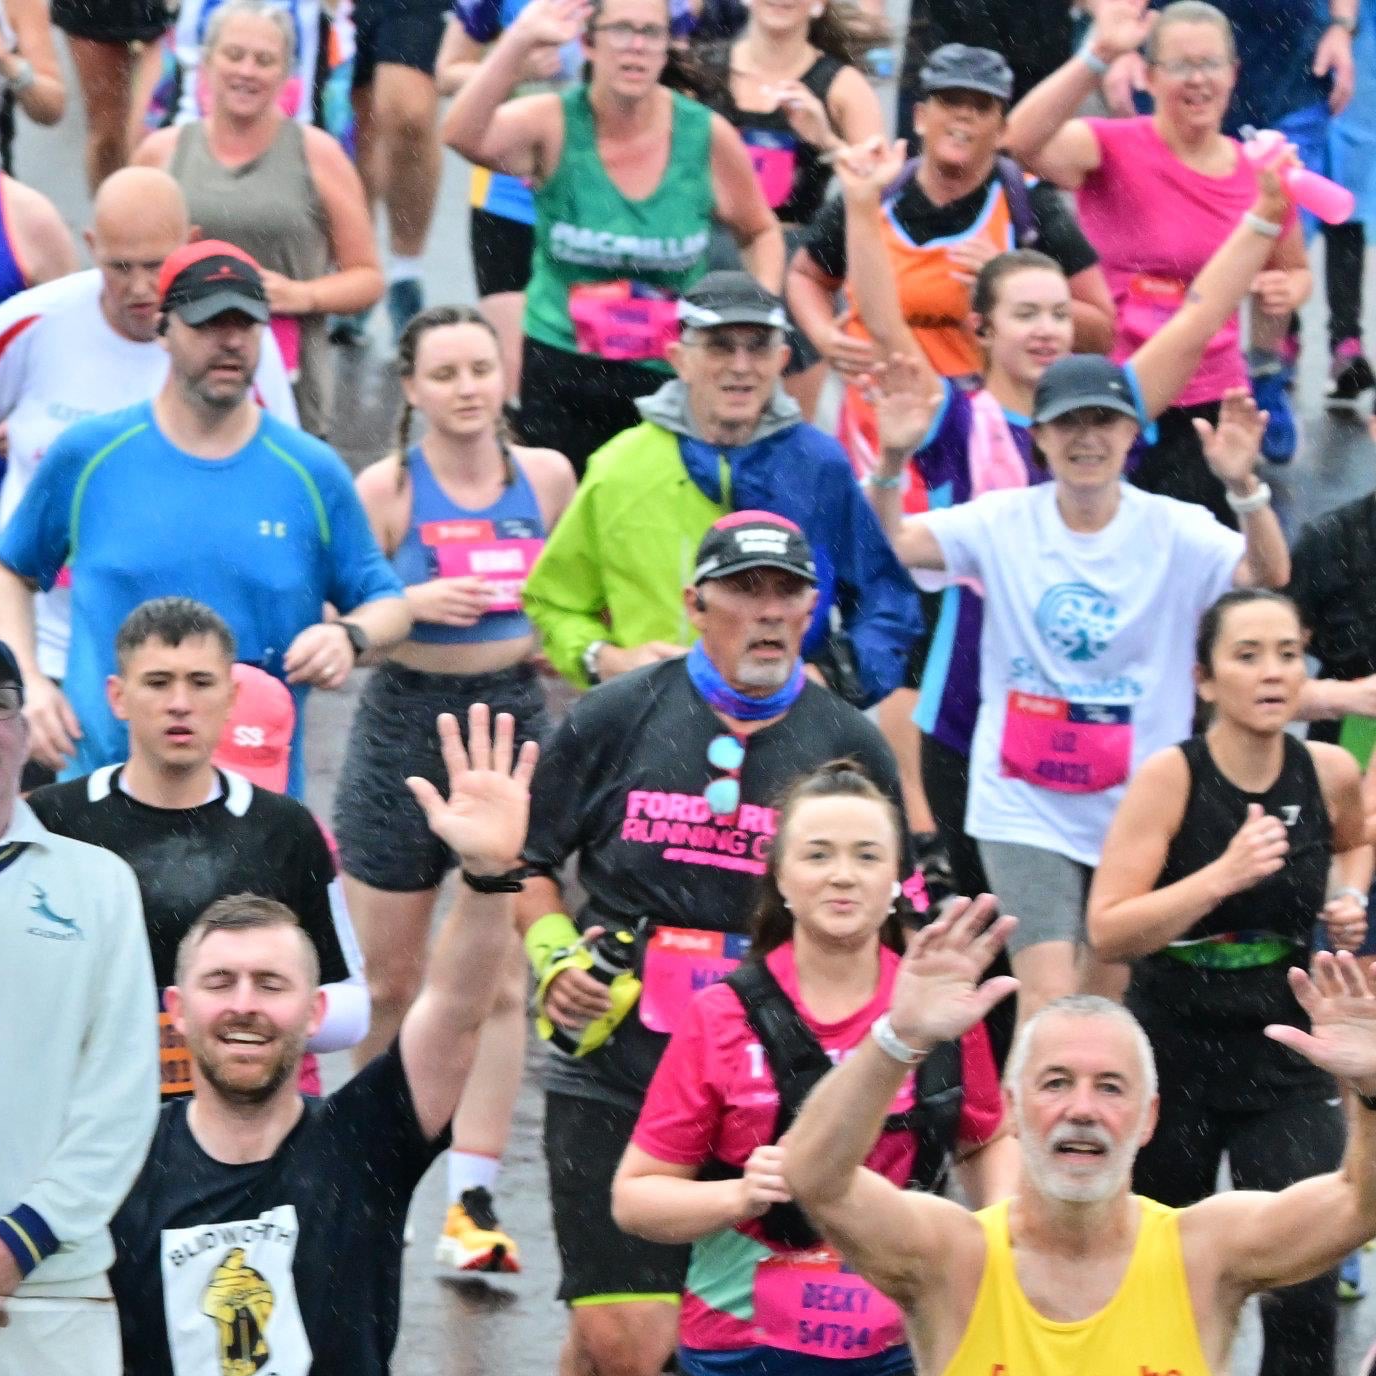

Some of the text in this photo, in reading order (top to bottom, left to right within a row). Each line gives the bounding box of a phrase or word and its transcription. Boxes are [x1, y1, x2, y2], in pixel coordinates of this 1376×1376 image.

[626, 790, 737, 826] FORD
[620, 818, 747, 855] RUNNING
[803, 1282, 872, 1314] BECKY
